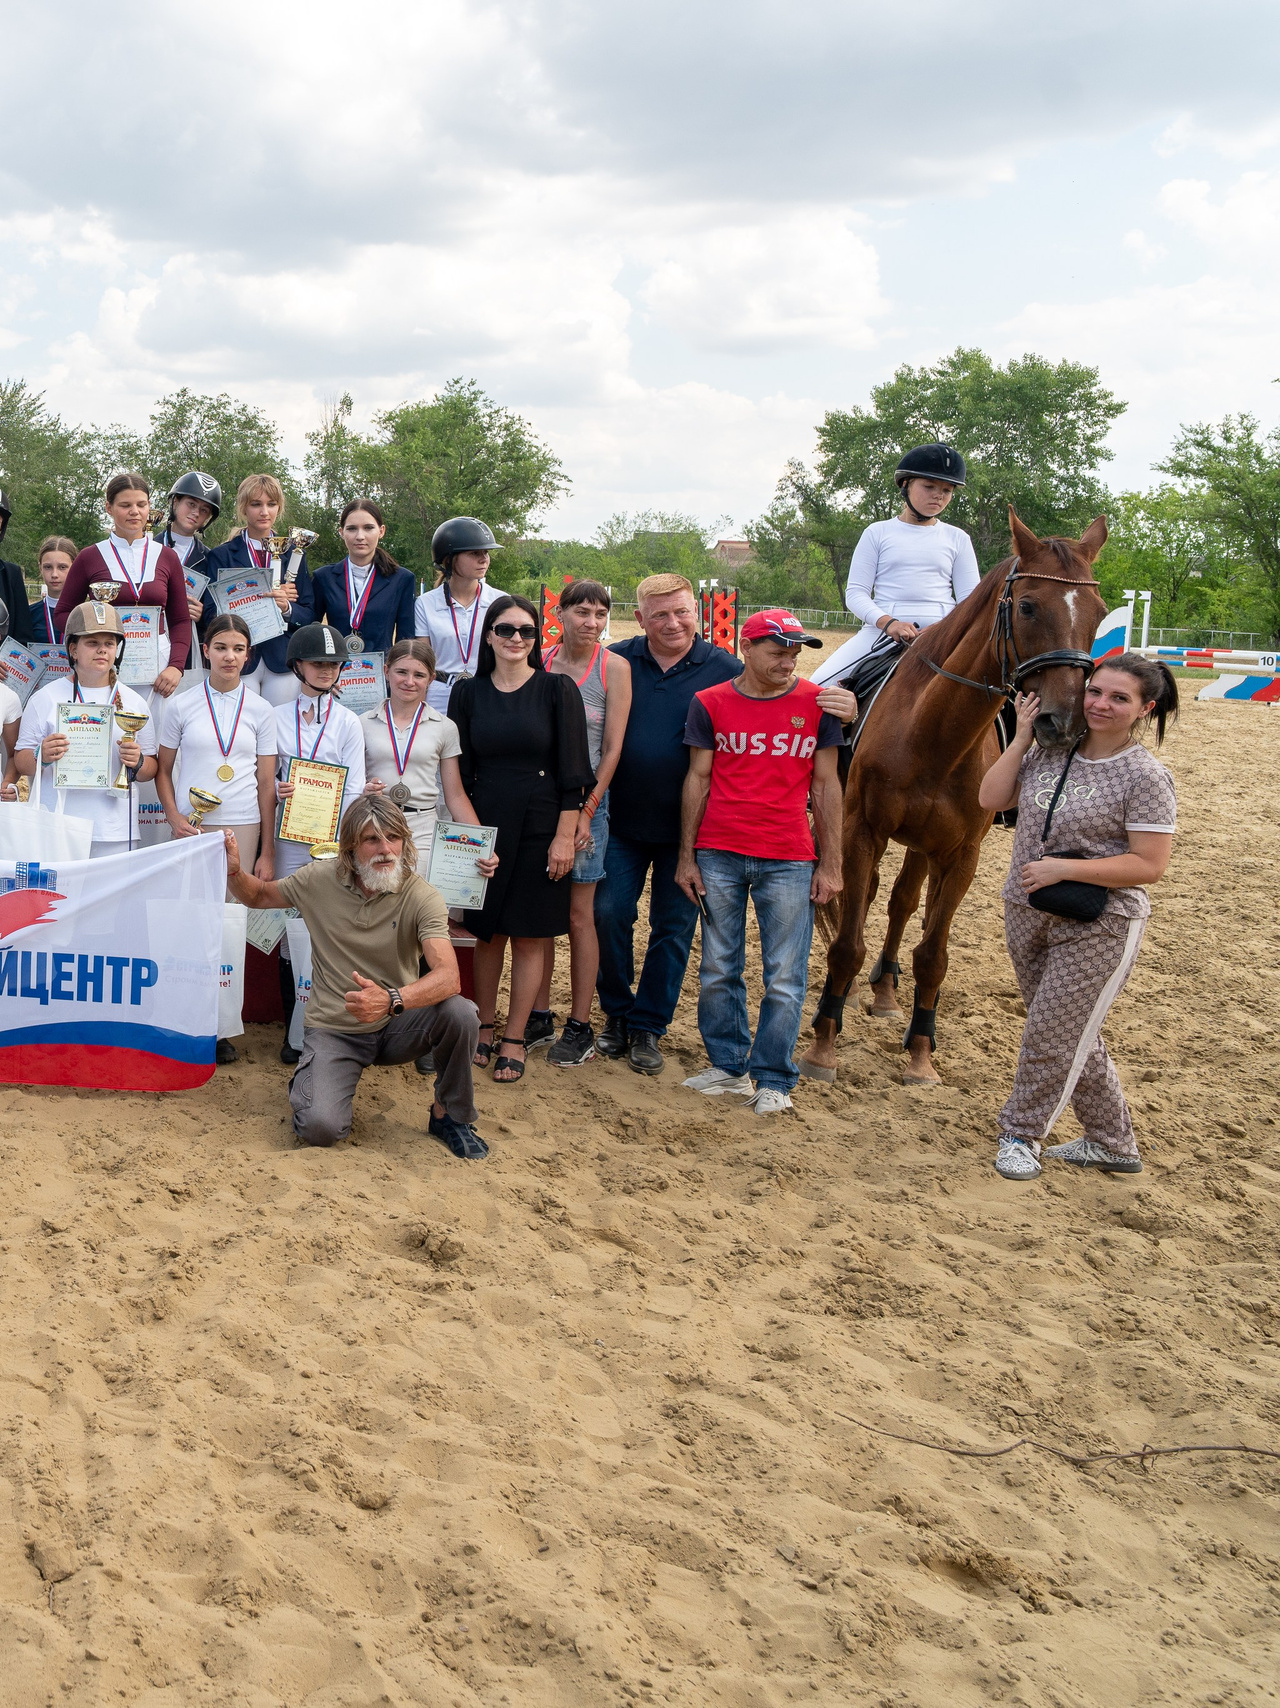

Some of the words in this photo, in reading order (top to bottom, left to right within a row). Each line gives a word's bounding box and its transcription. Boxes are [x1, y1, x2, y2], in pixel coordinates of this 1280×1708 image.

[123, 631, 151, 639] ИПЛОМ
[1260, 656, 1275, 667] 10
[46, 665, 71, 673] ПЛОМ
[340, 676, 376, 687] ДИПЛОМ
[715, 732, 818, 759] RUSSIA
[299, 776, 333, 789] ГРАМОТА
[444, 844, 481, 854] ДИПЛОМ
